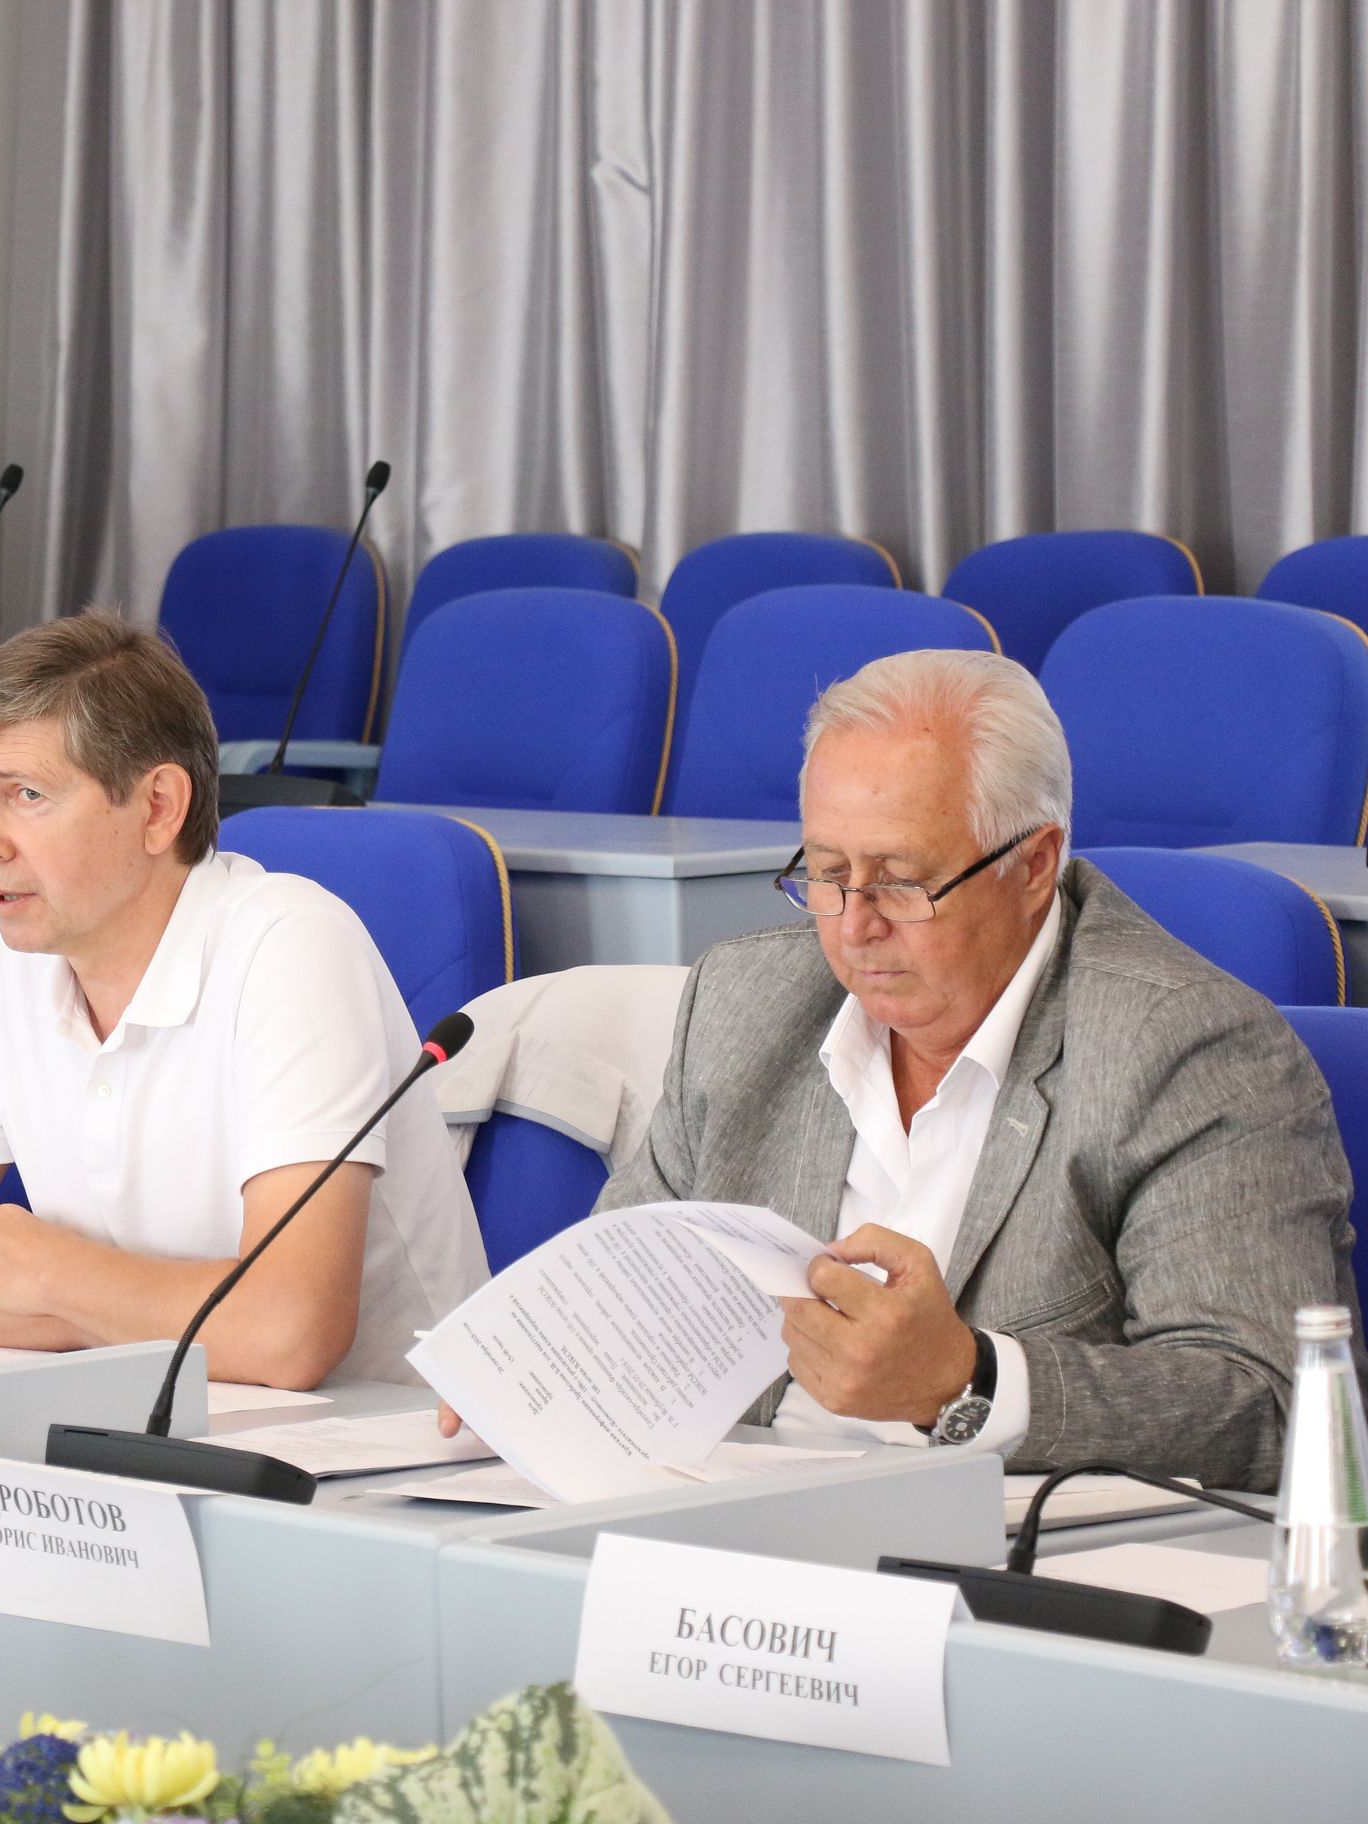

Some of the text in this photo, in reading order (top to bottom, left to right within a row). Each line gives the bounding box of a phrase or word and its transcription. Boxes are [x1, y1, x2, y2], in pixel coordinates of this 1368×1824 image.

[41, 1534, 140, 1569] ИВАНОВИЧ
[674, 1607, 839, 1664] БАСОВИЧ
[648, 1651, 860, 1707] ЕГОР СЕРГЕЕВИЧ
